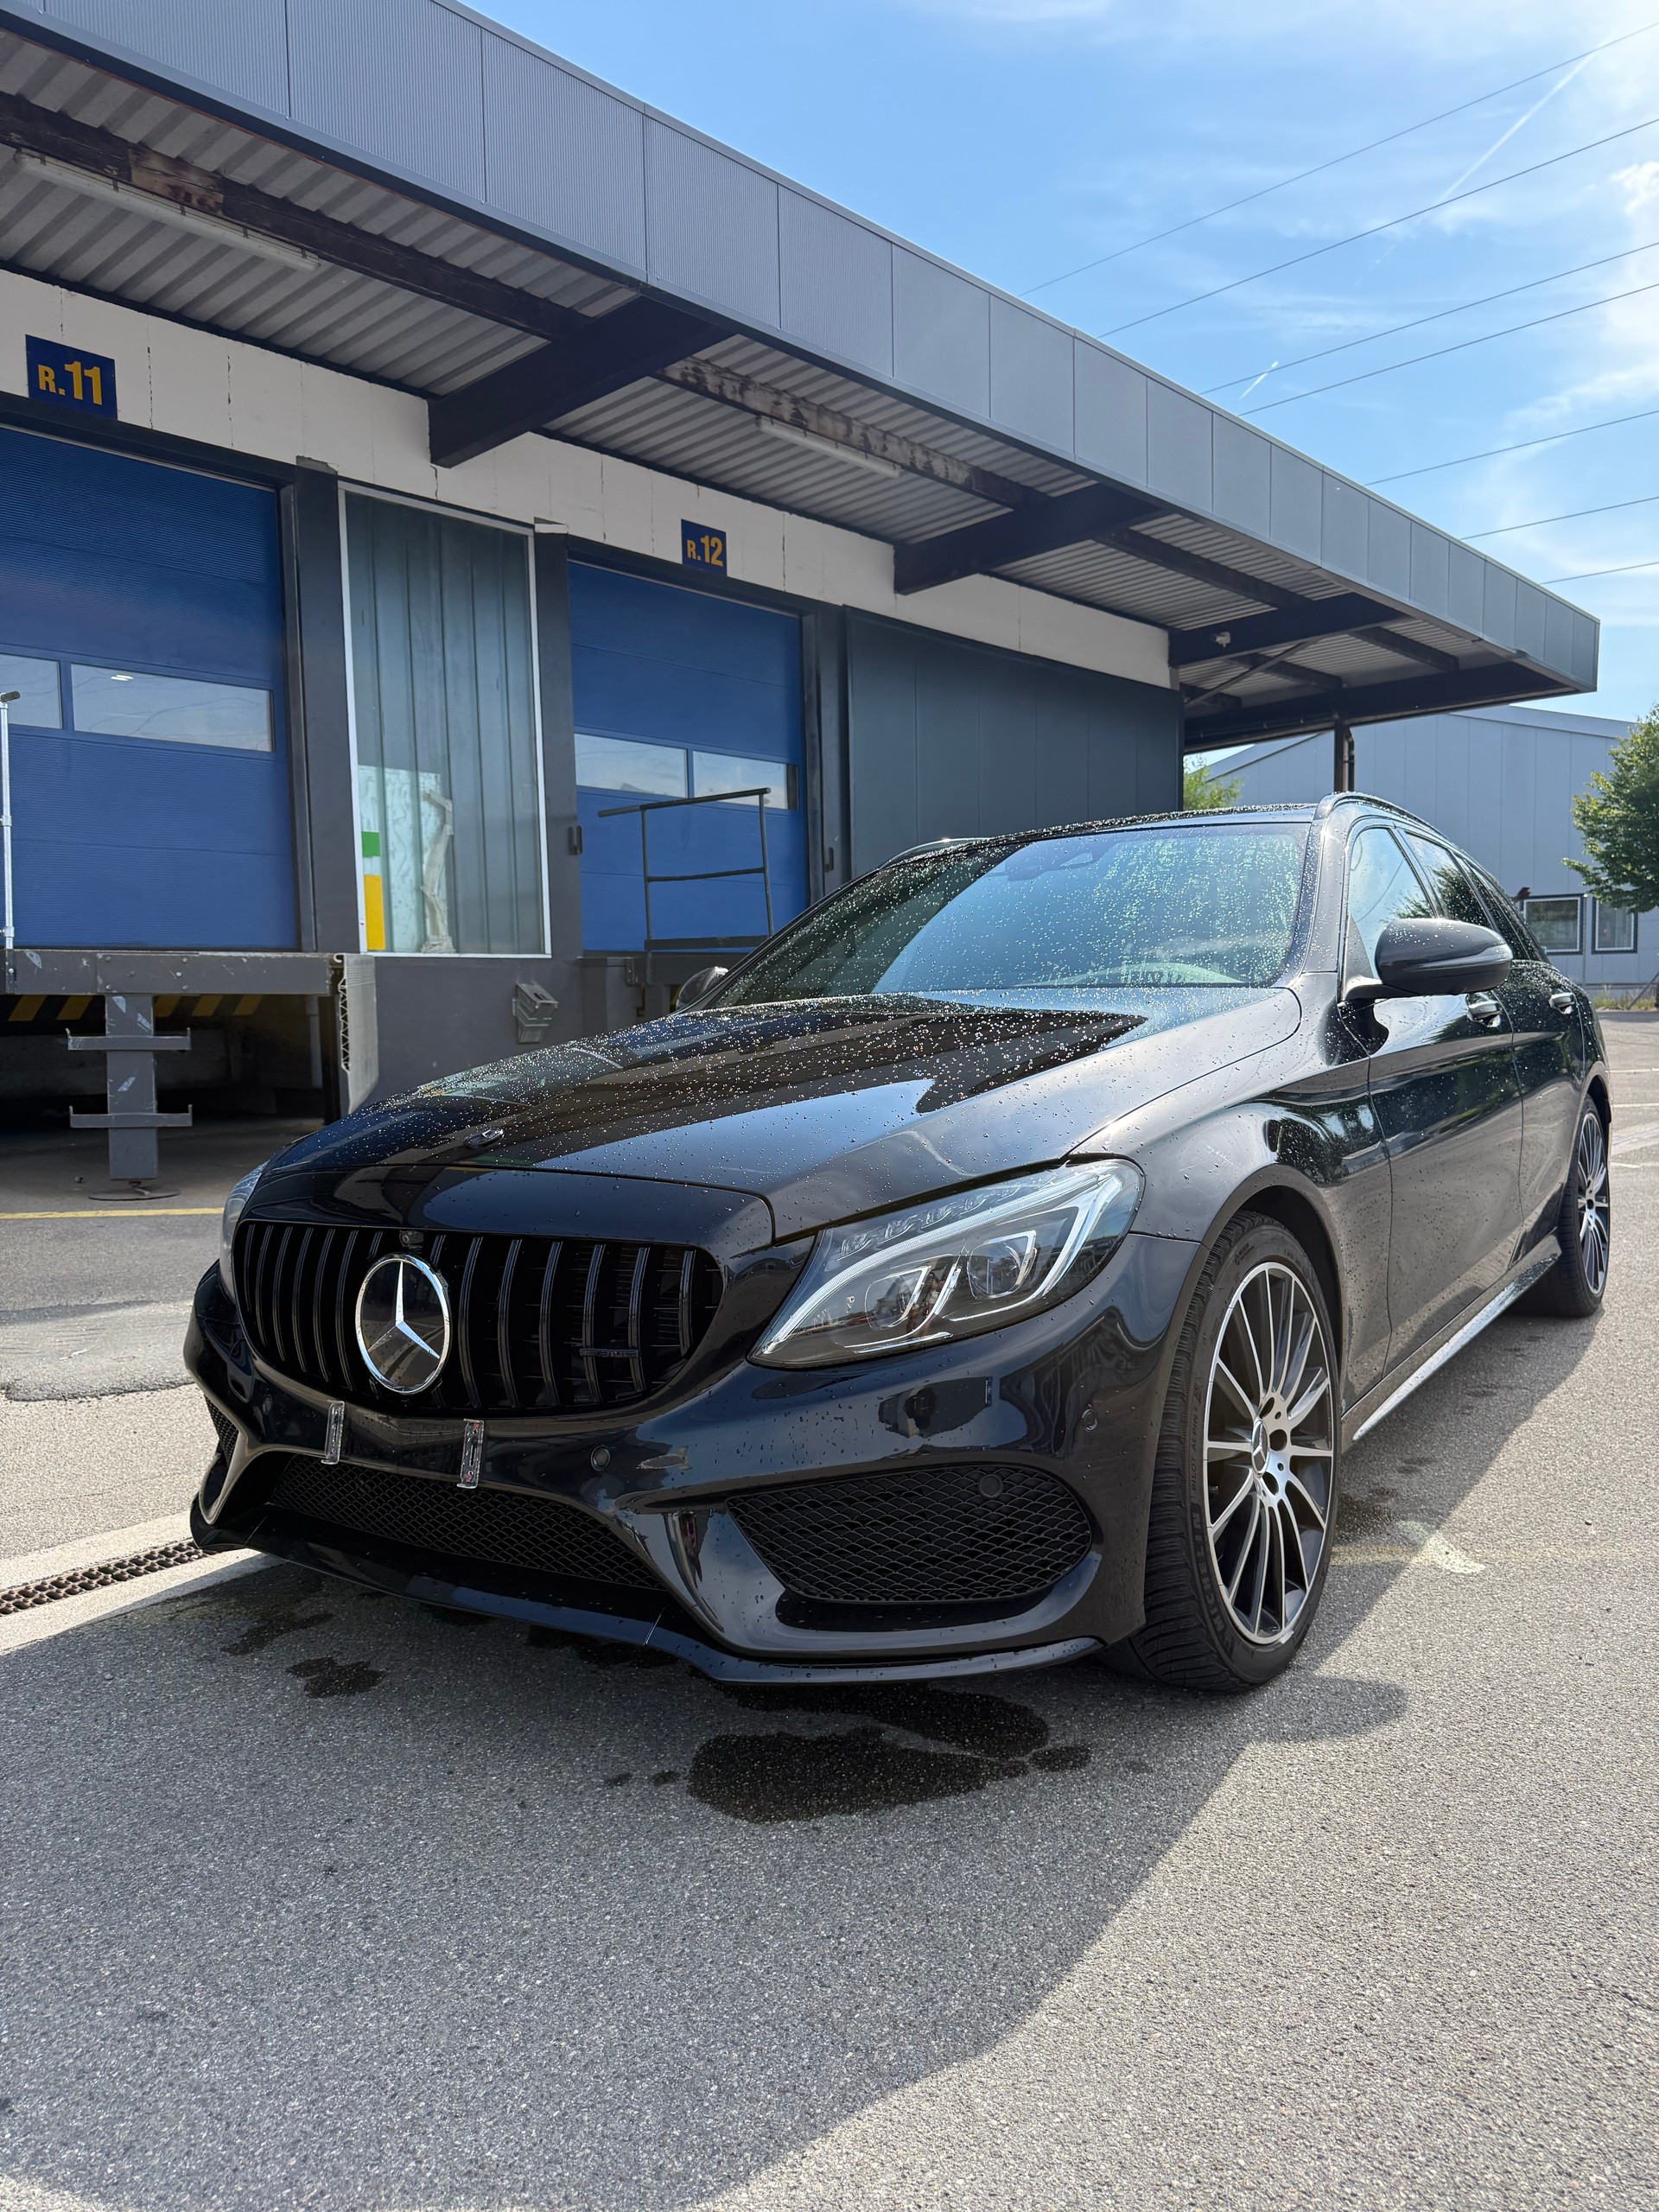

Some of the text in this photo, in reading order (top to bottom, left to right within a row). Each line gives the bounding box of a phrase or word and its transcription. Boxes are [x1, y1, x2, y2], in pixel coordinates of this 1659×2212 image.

[37, 360, 103, 406] R.11
[686, 535, 723, 567] R.12
[1192, 1512, 1226, 1632] MICHELIN
